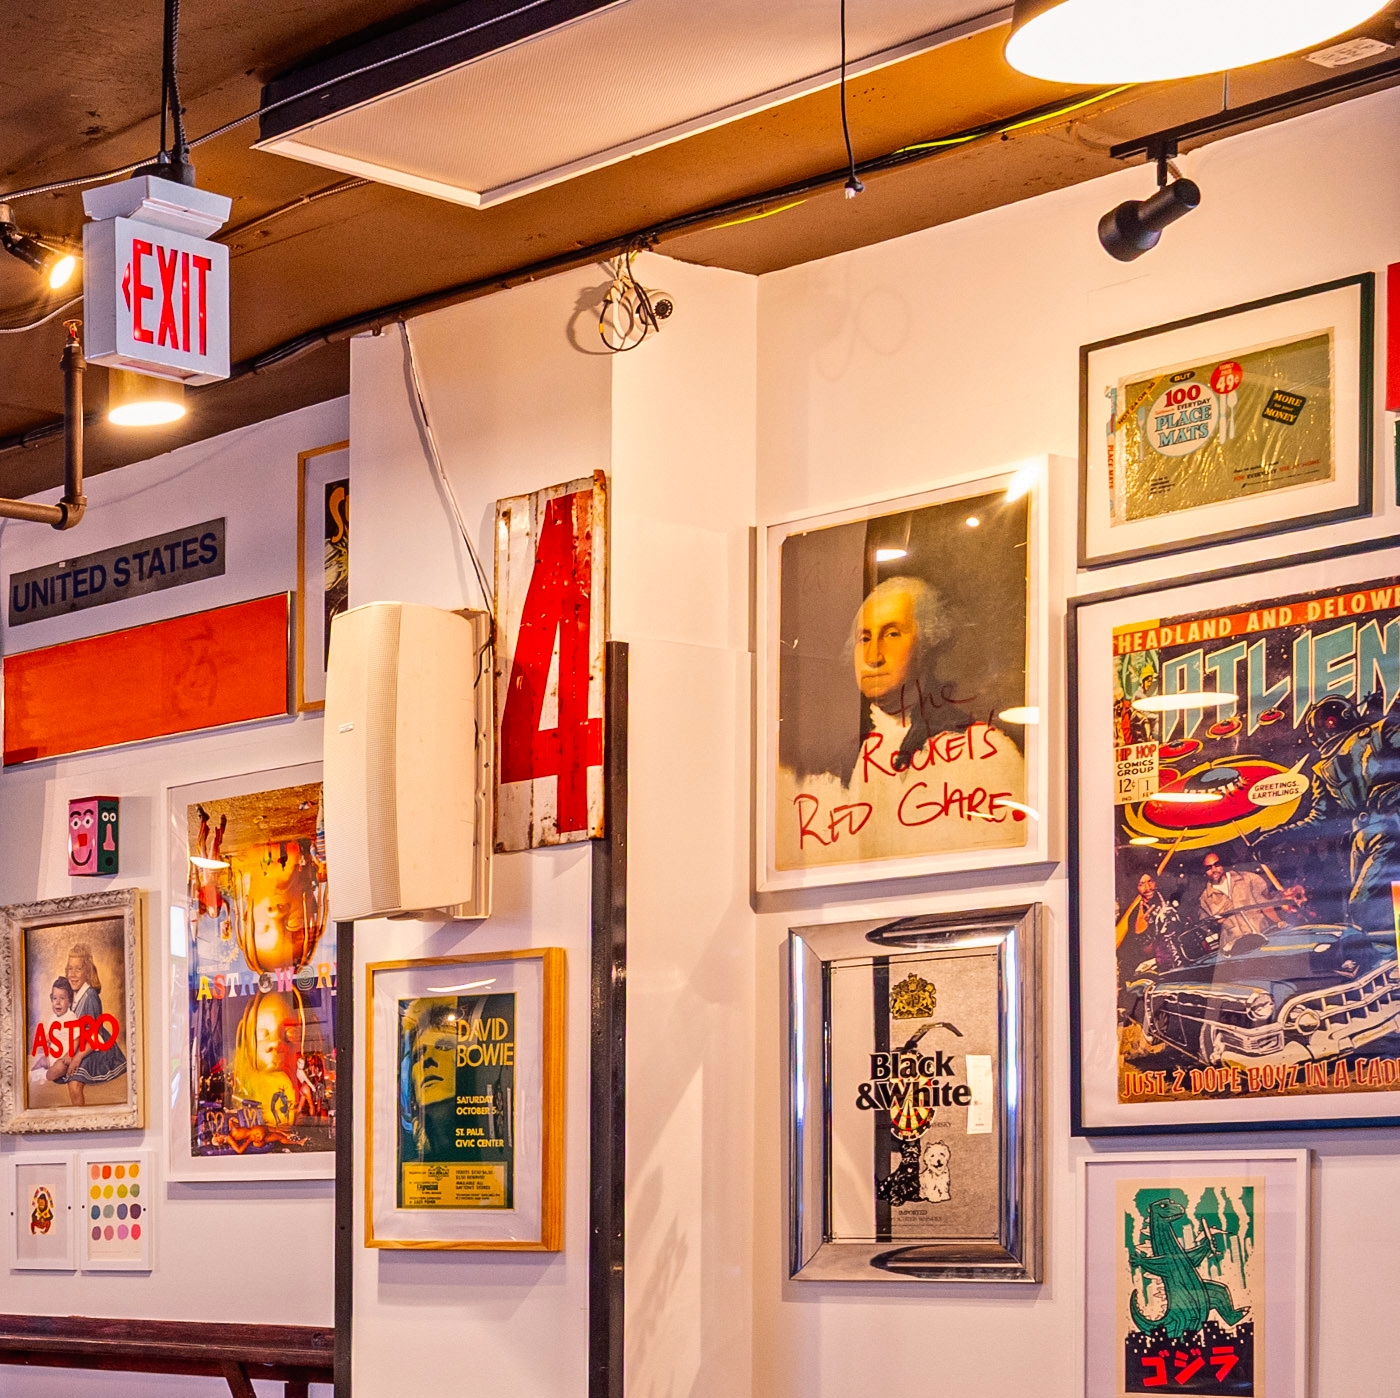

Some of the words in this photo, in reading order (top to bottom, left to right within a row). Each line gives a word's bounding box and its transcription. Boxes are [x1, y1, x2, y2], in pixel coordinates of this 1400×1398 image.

[132, 238, 212, 356] EXIT
[1174, 372, 1192, 382] BUT
[1164, 384, 1201, 408] 100
[1176, 398, 1211, 411] EVERYDAY
[1274, 393, 1303, 407] MORE
[1155, 404, 1212, 432] PLACE
[1264, 407, 1296, 422] MONEY
[1158, 422, 1209, 448] MATS
[12, 564, 107, 613] UNITED
[113, 533, 218, 588] STATES
[1117, 618, 1232, 654] HEADLAND
[1246, 607, 1292, 633] AND
[501, 493, 602, 834] 4
[1115, 747, 1132, 762] HIP
[1135, 743, 1157, 759] HOP
[1117, 759, 1154, 770] COMICS
[1117, 766, 1154, 777] GROUP
[1145, 782, 1150, 791] 1
[793, 793, 873, 850] RED
[32, 1012, 120, 1060] ASTRO
[457, 1018, 509, 1042] DAVID
[457, 1043, 514, 1067] BOWIE
[870, 1050, 955, 1081] Black
[1121, 1070, 1167, 1099] JUST
[1172, 1065, 1185, 1093] 2
[1190, 1066, 1242, 1094] DOPE
[1247, 1064, 1300, 1093] BOYZ
[1305, 1060, 1328, 1088] IN
[1333, 1060, 1350, 1089] A
[456, 1107, 489, 1115] OCTOBER
[457, 1096, 494, 1104] SATURDAY
[456, 1139, 475, 1148] CIVIC
[477, 1139, 504, 1148] CENTER
[466, 1128, 485, 1136] PAUL
[1140, 1345, 1240, 1387] ゴジラ
